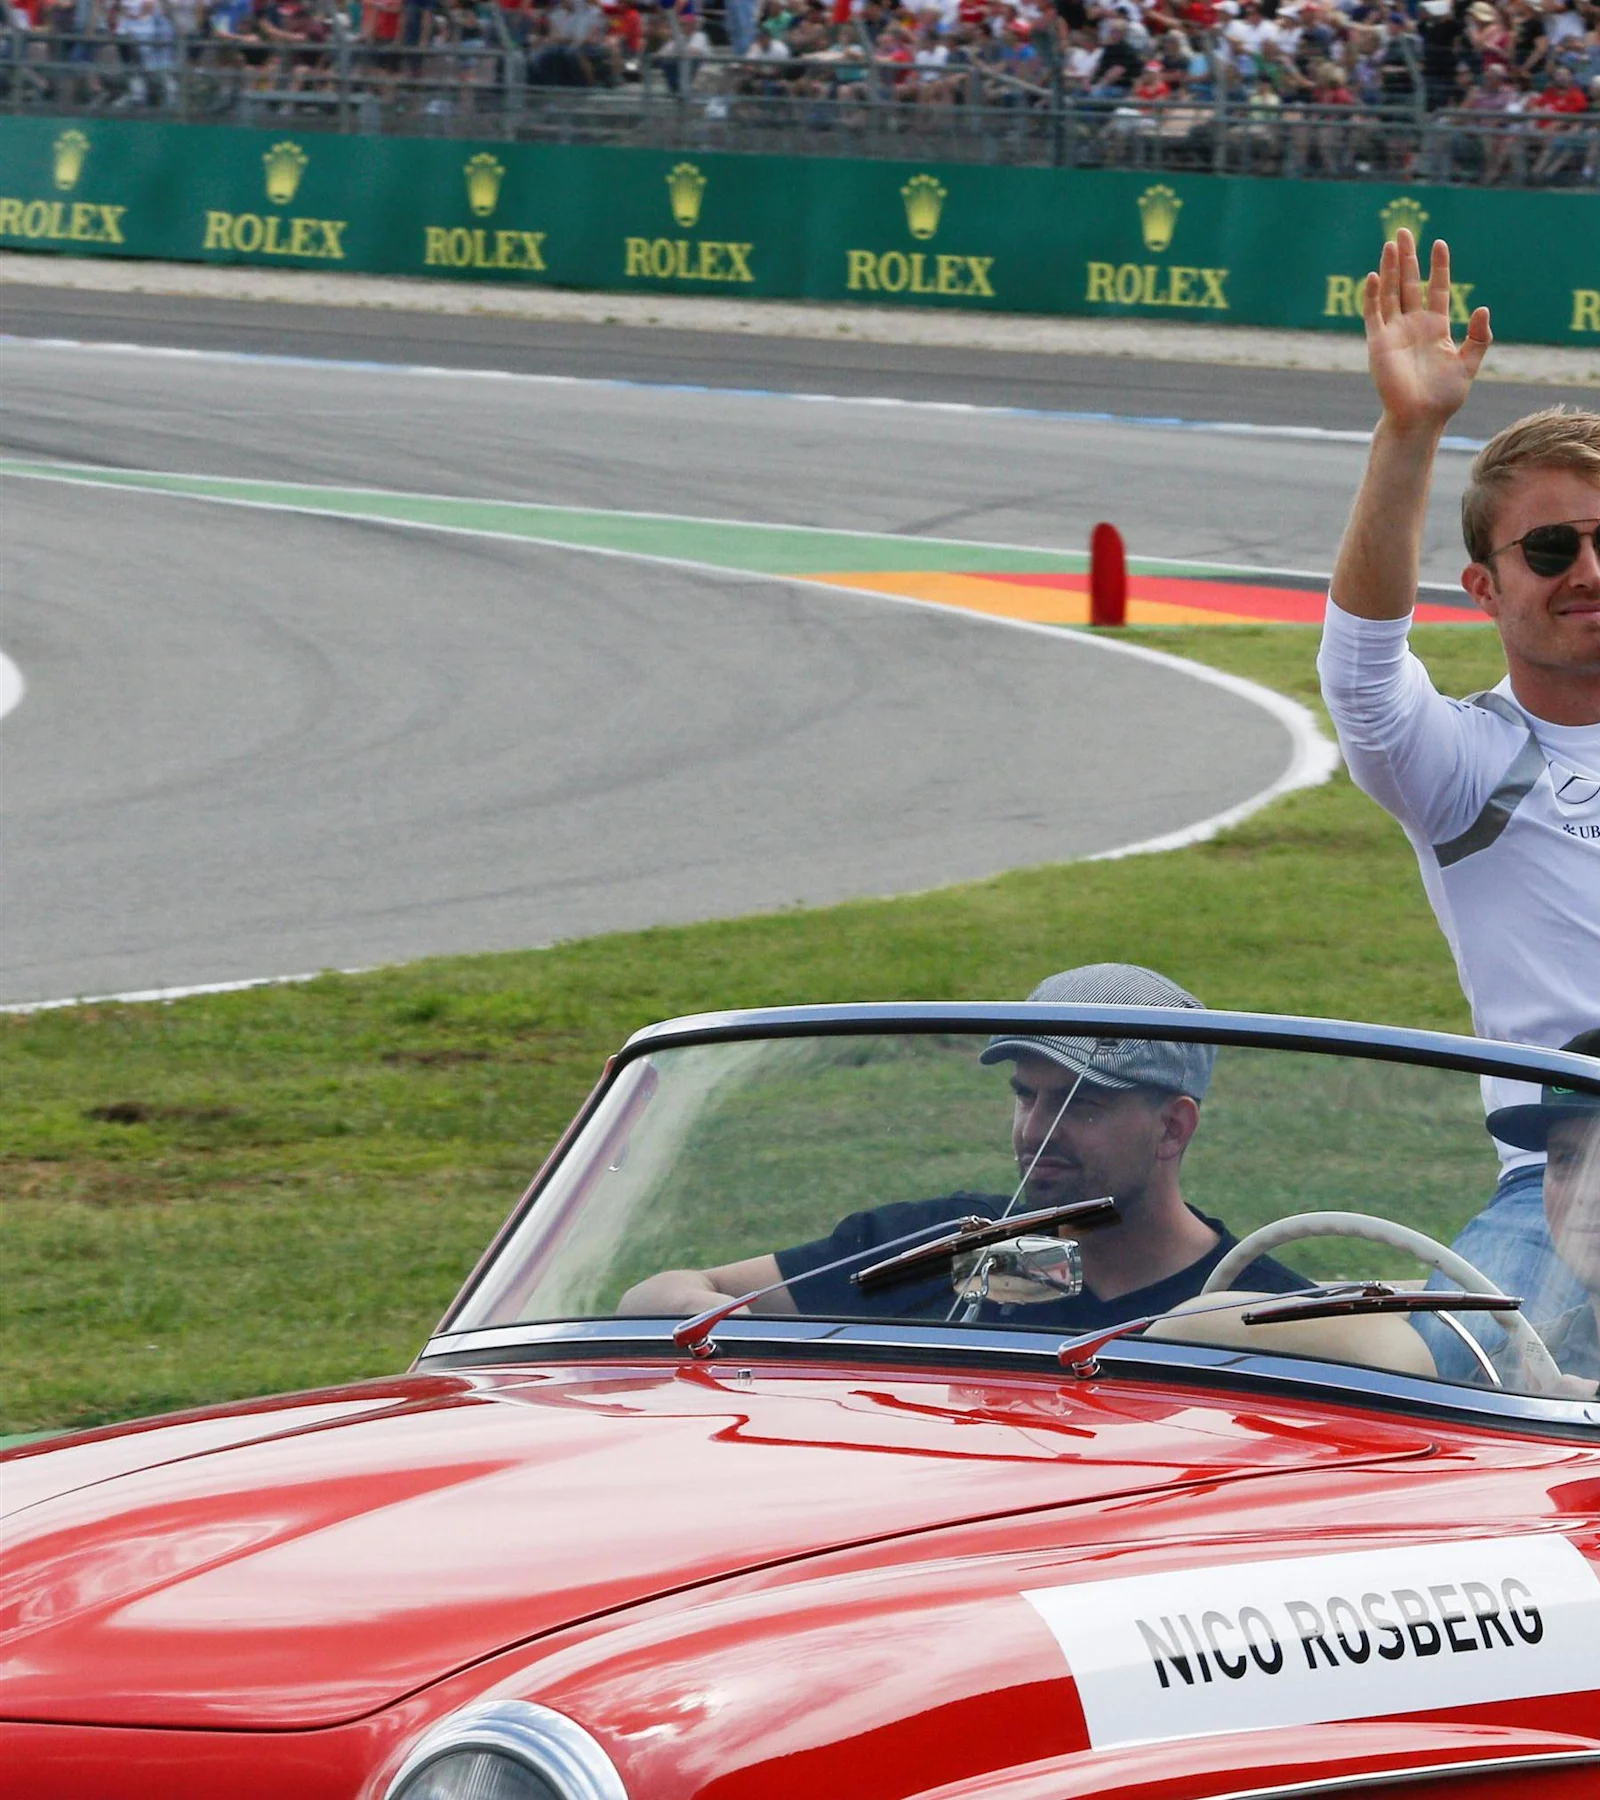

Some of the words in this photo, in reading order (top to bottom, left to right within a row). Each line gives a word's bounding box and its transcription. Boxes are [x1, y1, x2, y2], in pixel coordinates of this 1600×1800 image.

[0, 198, 127, 243] ROLEX
[203, 211, 346, 258] ROLEX
[424, 226, 546, 270] ROLEX
[624, 236, 754, 282] ROLEX
[846, 250, 994, 296] ROLEX
[1086, 262, 1229, 309] ROLEX
[1135, 1606, 1284, 1688] NICO
[1284, 1577, 1546, 1669] ROSBERG
